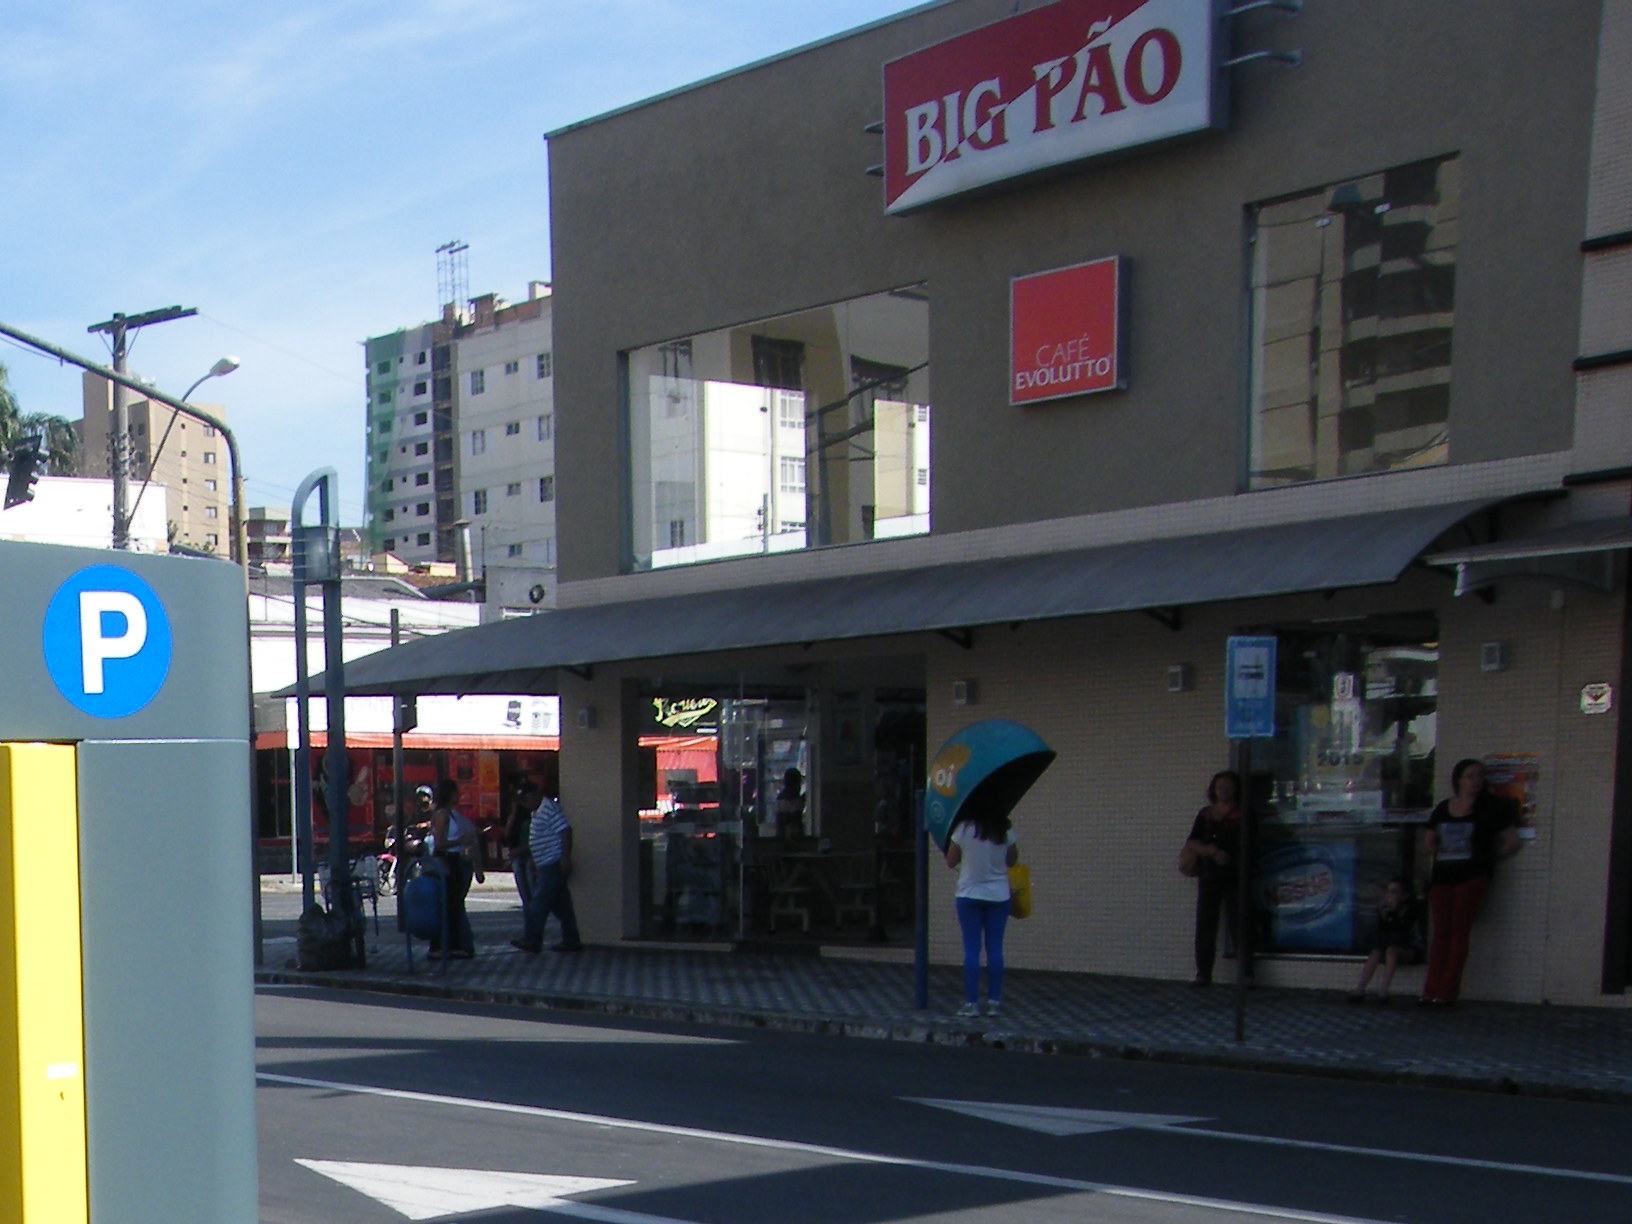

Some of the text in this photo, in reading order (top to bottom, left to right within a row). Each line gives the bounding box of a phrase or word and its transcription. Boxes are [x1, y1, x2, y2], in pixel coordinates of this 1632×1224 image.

[905, 15, 1182, 175] BIG PÃO
[1015, 356, 1111, 390] EVOLUTTO
[1036, 332, 1089, 367] CAFÉ
[79, 591, 148, 695] P
